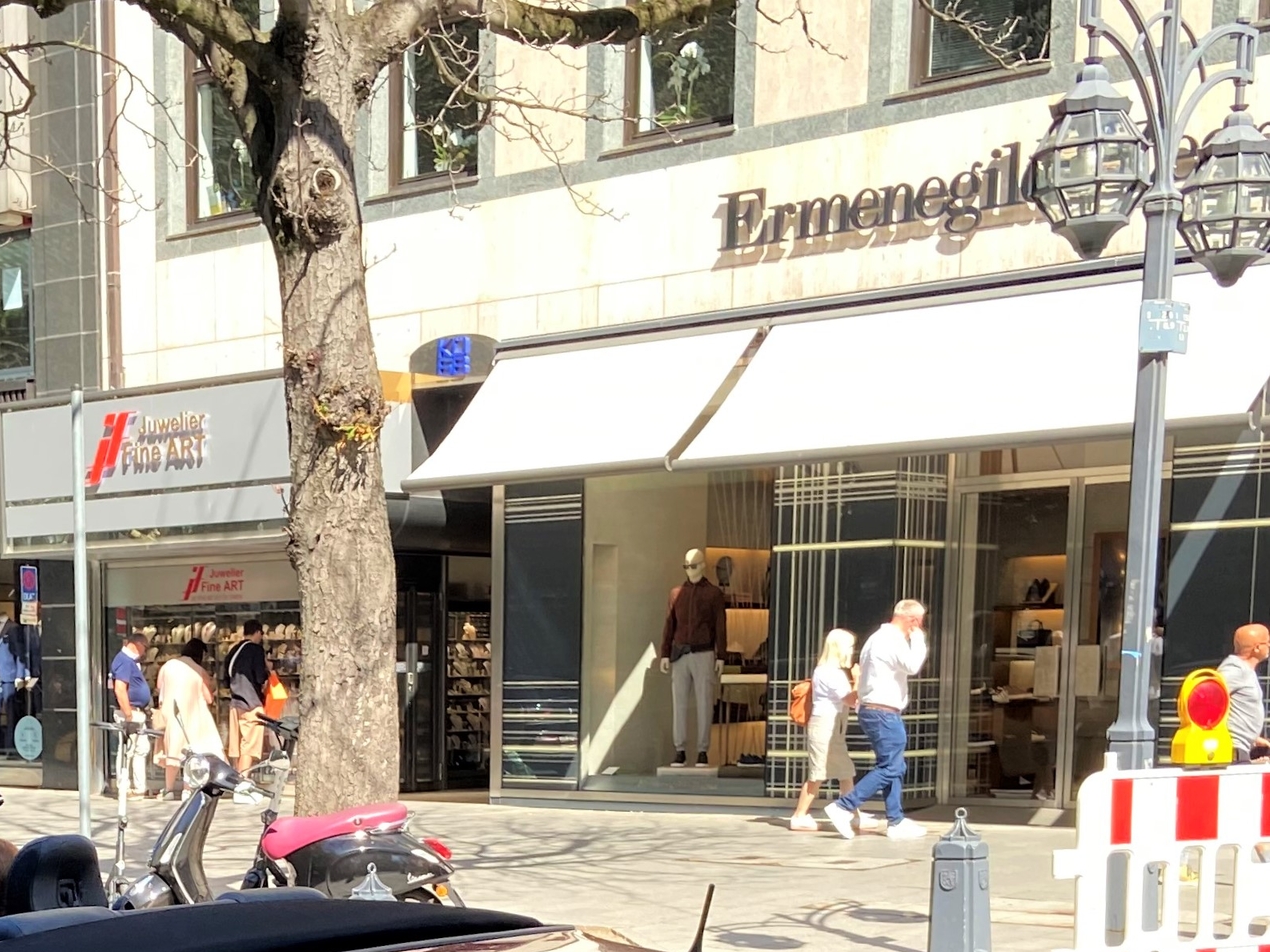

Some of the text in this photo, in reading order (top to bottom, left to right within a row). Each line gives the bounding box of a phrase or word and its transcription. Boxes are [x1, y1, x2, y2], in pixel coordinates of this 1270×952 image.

[718, 141, 1036, 252] Ermenegil
[138, 411, 207, 436] Juwelier
[121, 434, 207, 467] Fine ART
[209, 567, 245, 578] Juwelier
[201, 579, 245, 592] Fine ART
